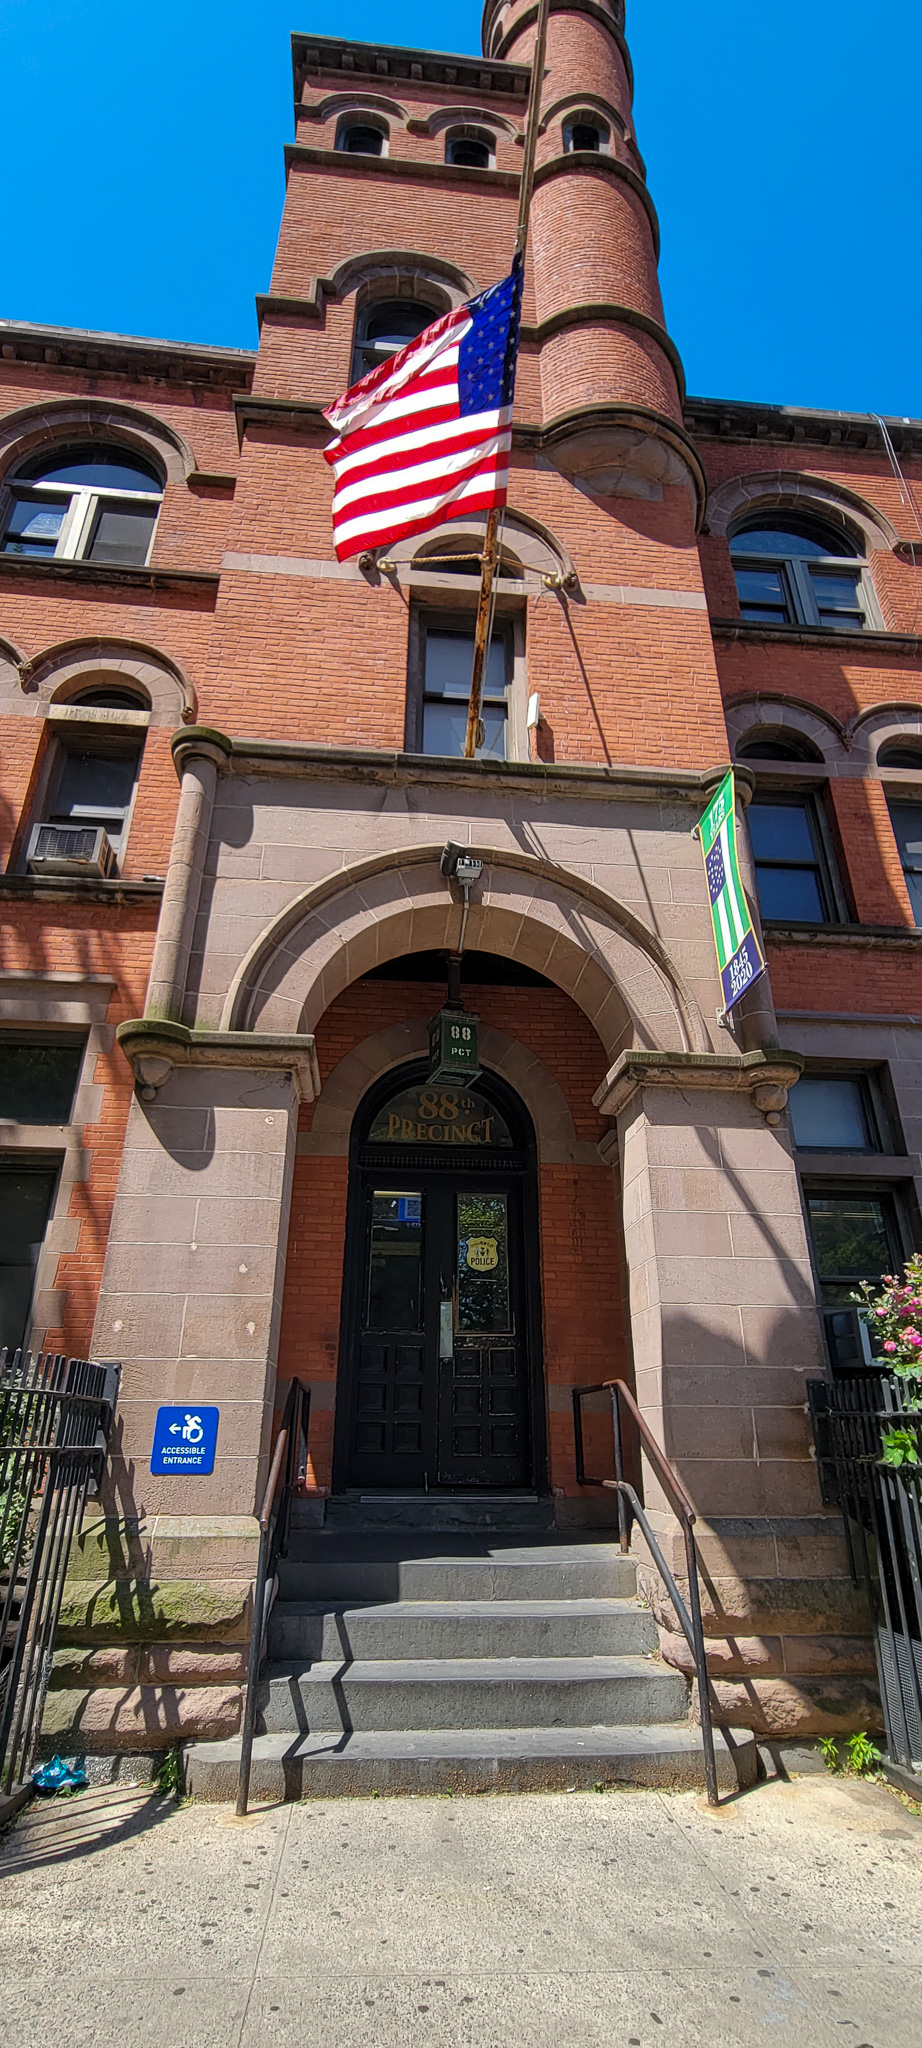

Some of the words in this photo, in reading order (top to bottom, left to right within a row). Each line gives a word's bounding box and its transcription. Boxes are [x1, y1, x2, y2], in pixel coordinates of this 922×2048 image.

[729, 945, 748, 981] 1845
[731, 961, 753, 997] 2020
[451, 1025, 471, 1041] 88
[451, 1047, 472, 1057] PCT
[418, 1091, 476, 1120] 88th
[388, 1112, 494, 1143] PRECINCT
